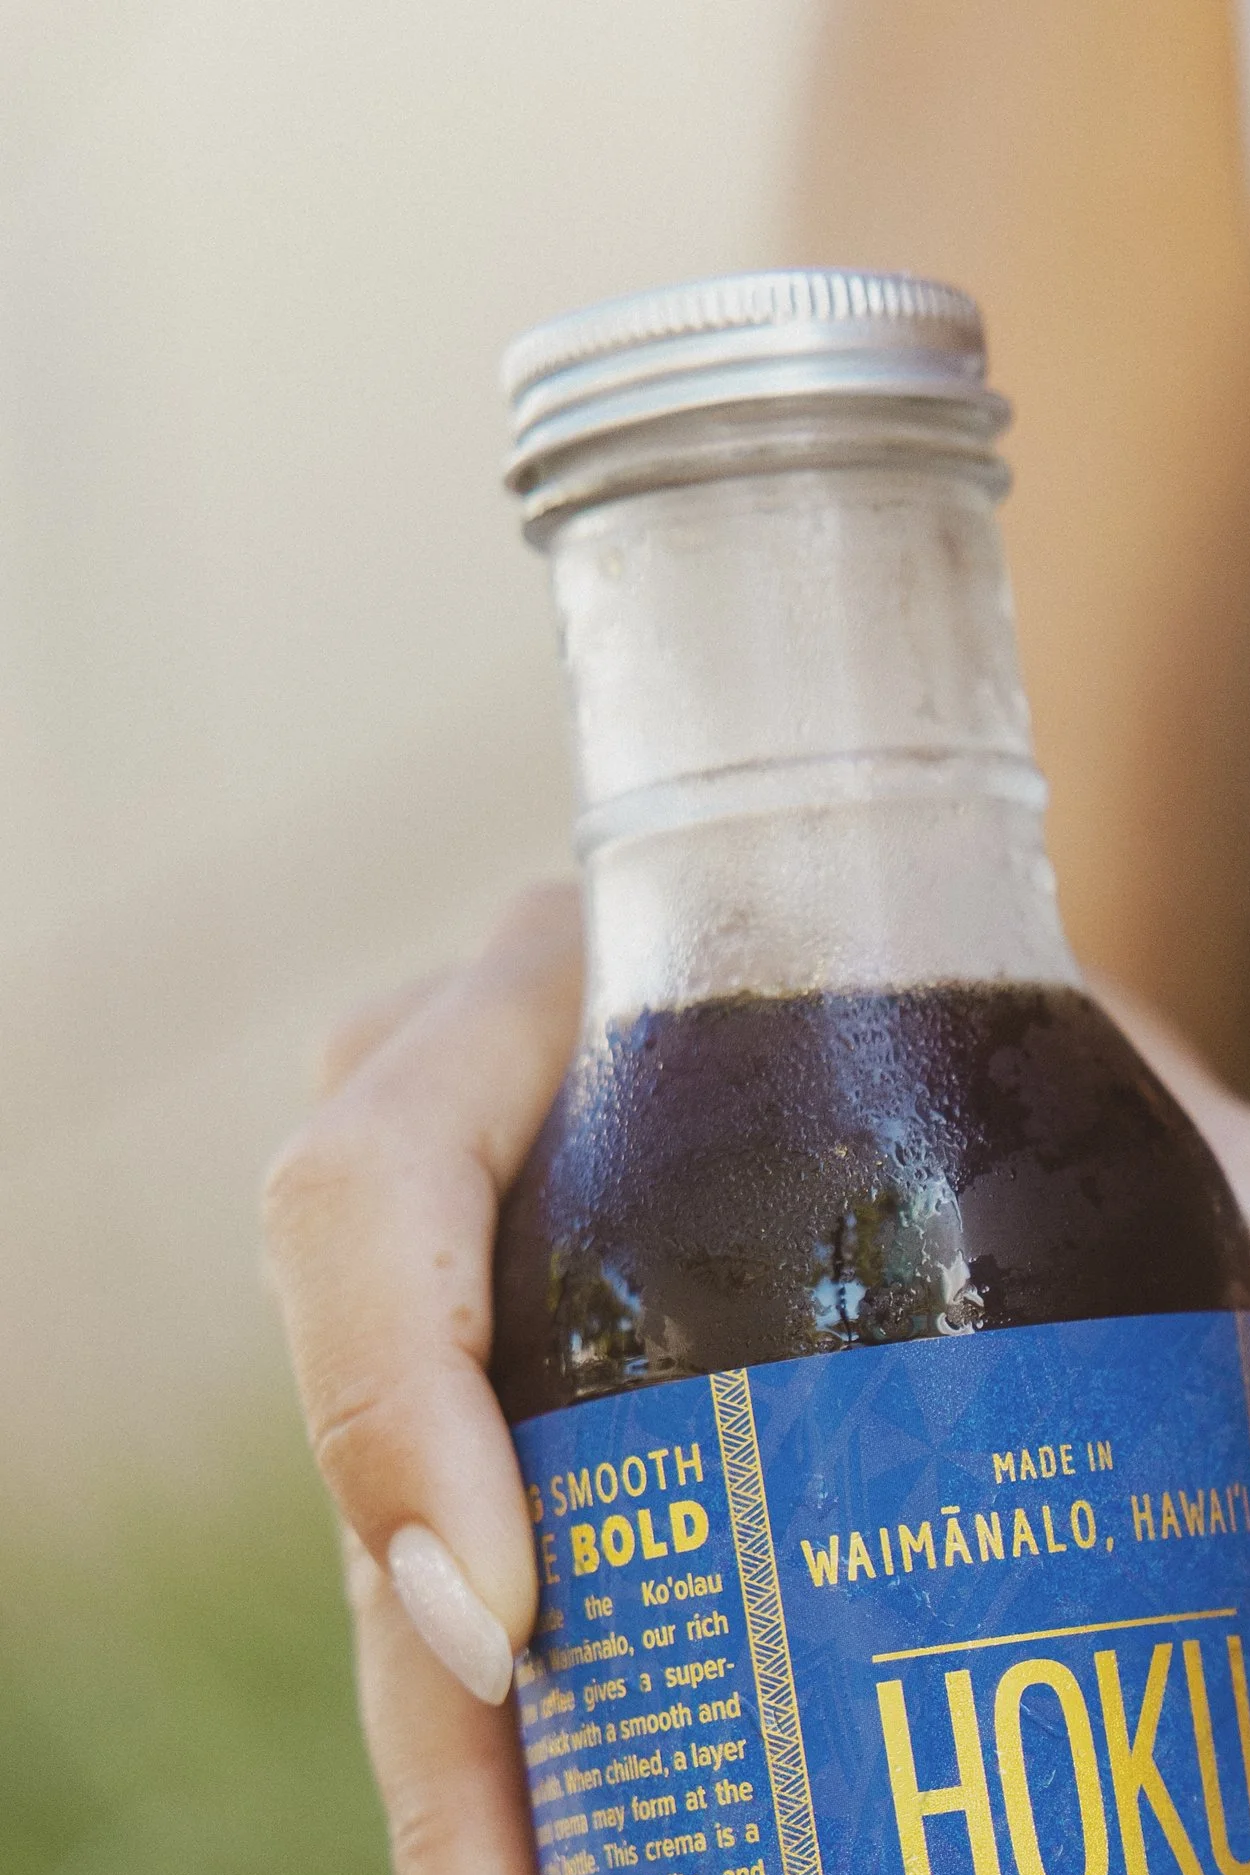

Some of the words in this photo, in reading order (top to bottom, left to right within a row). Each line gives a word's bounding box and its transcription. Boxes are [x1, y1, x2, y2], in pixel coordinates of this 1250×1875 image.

[551, 1441, 704, 1517] SMOOTH
[992, 1444, 1076, 1484] MADE
[1087, 1440, 1114, 1472] IN
[570, 1500, 709, 1577] BOLD
[800, 1499, 1115, 1587] WAIMĀNALO,
[584, 1595, 613, 1620] the
[641, 1572, 723, 1606] Ko'olau
[642, 1625, 676, 1649] our
[687, 1610, 729, 1641] rich
[583, 1677, 627, 1712] gives
[639, 1672, 652, 1692] a
[665, 1657, 735, 1688] super-
[605, 1723, 617, 1743] a
[620, 1702, 692, 1740] smooth
[699, 1691, 742, 1724] and
[605, 1749, 670, 1785] chilled,
[673, 1750, 688, 1771] a
[690, 1738, 746, 1771] layer
[592, 1805, 625, 1832] may
[631, 1795, 677, 1821] form
[685, 1786, 708, 1811] at
[715, 1779, 753, 1806] the
[604, 1840, 639, 1869] This
[645, 1831, 707, 1861] crema
[715, 1822, 736, 1848] is
[745, 1823, 760, 1843] a
